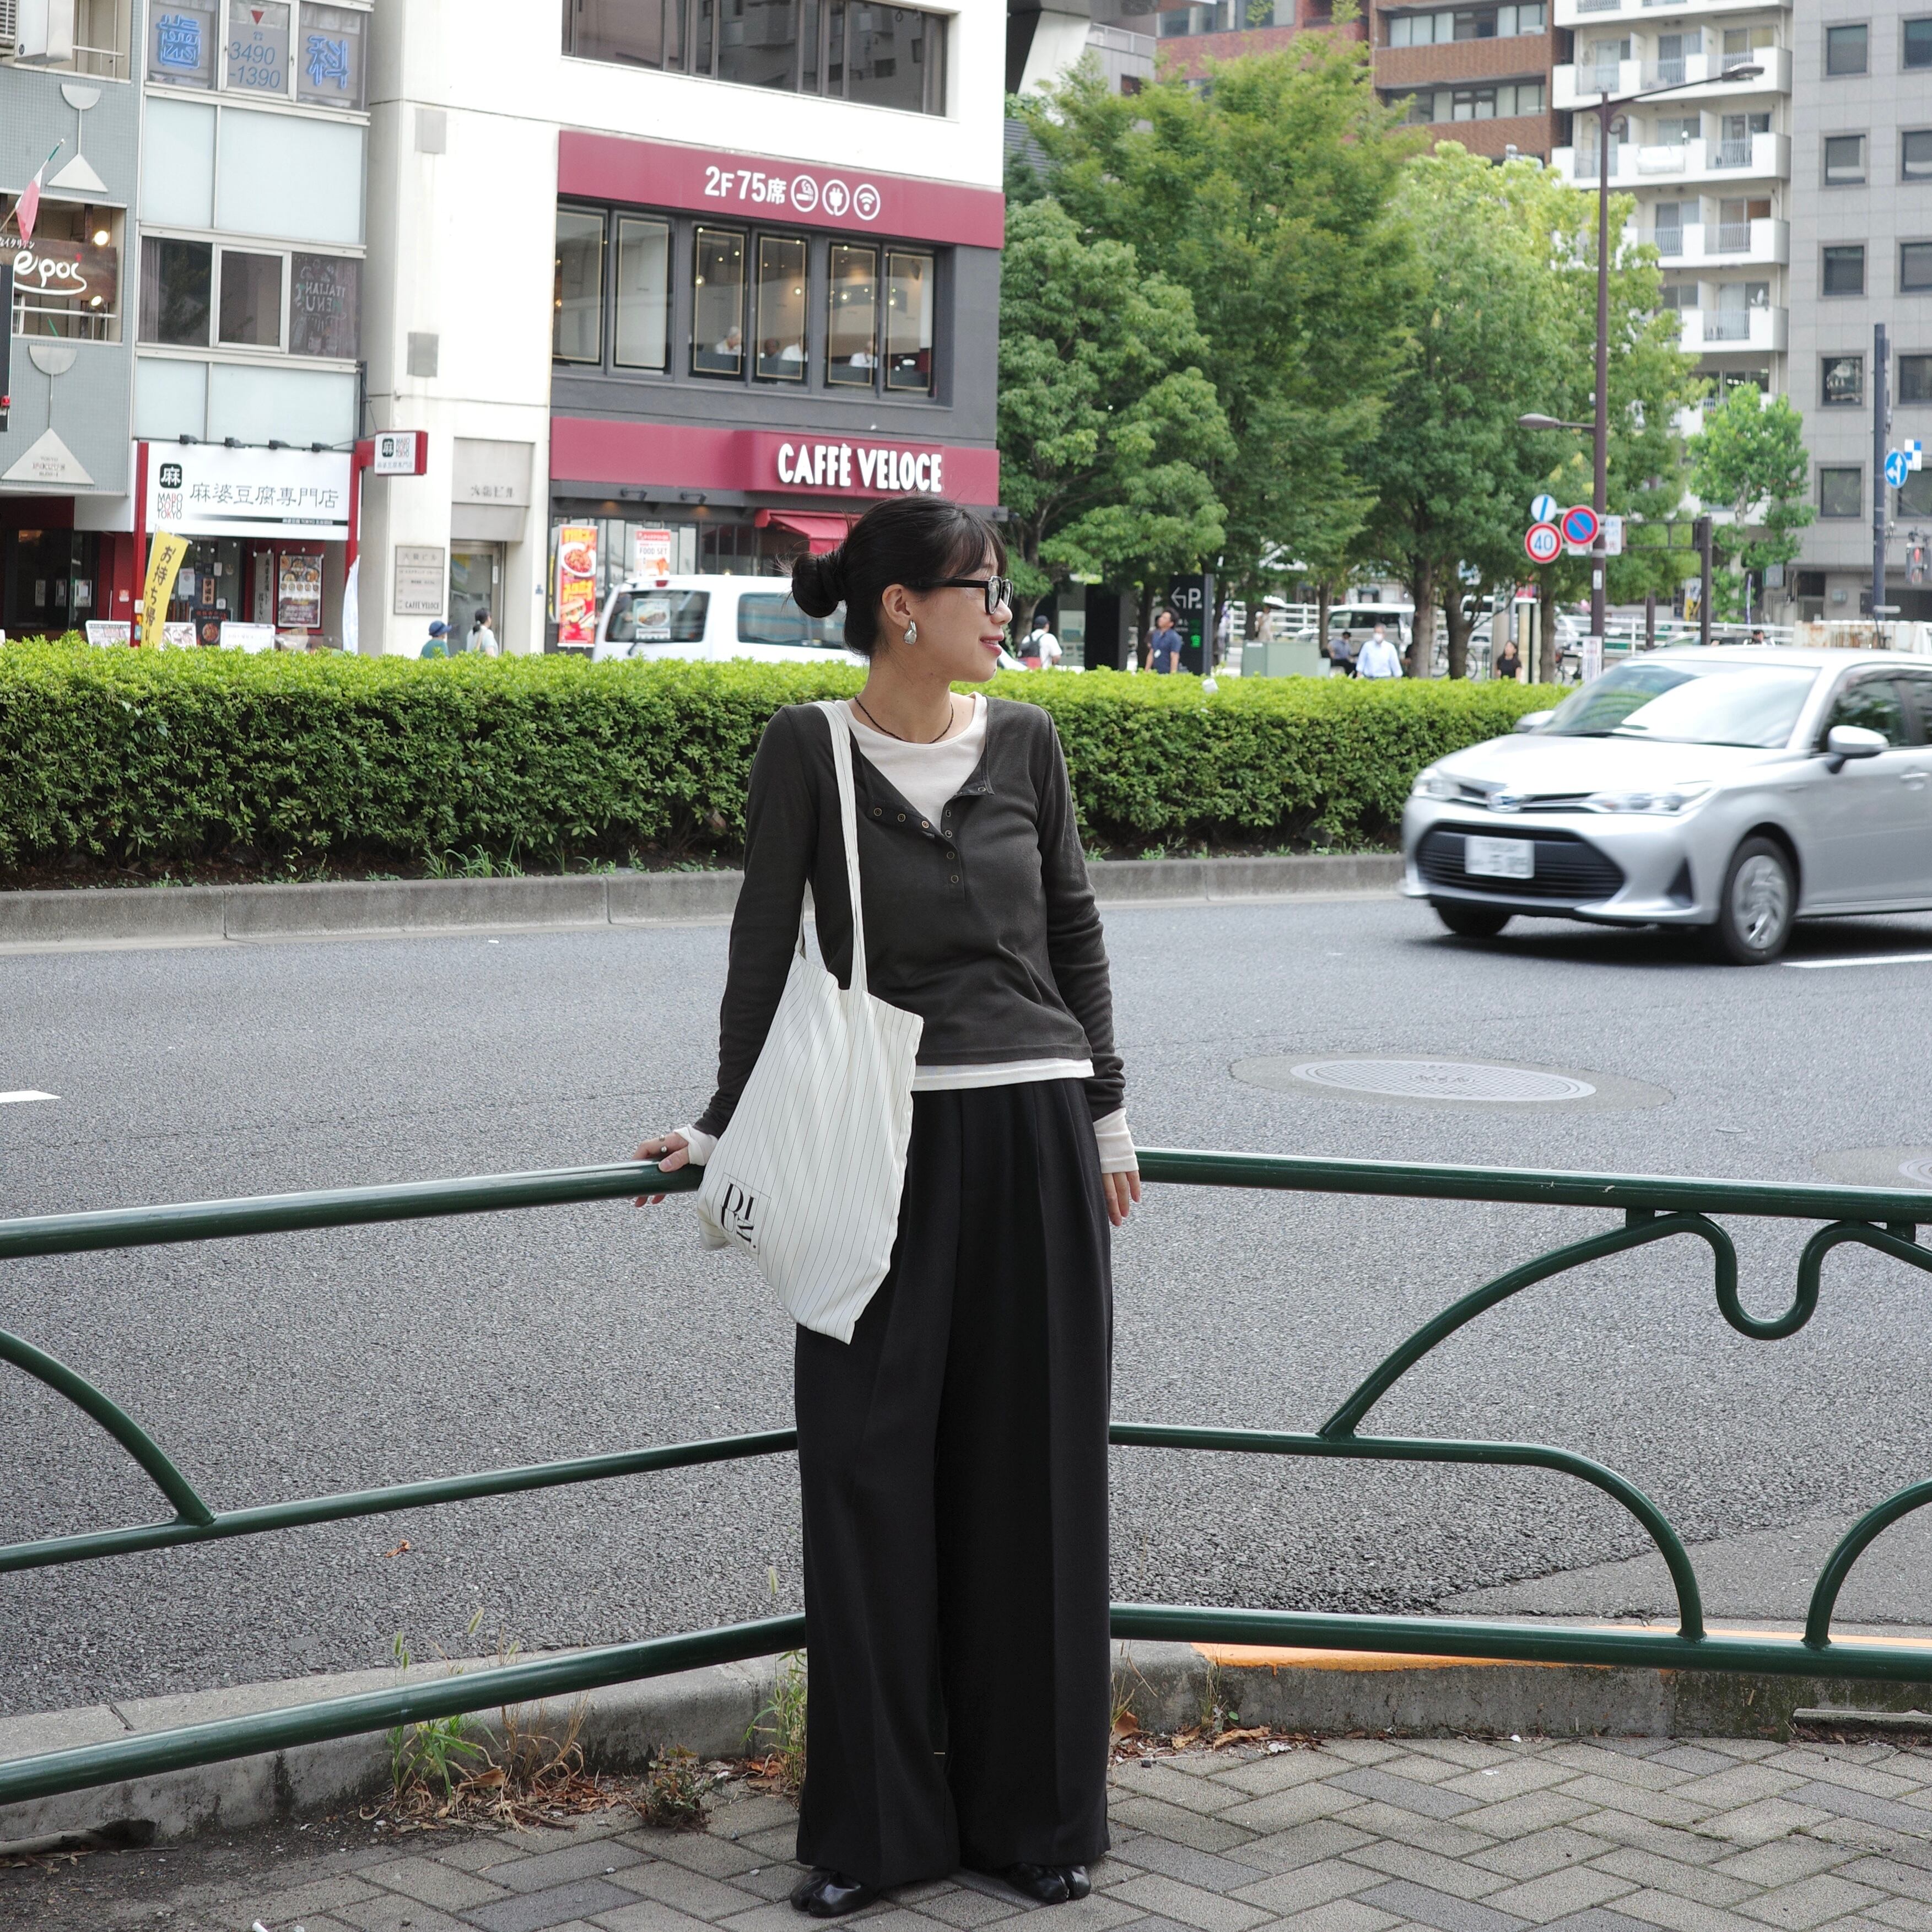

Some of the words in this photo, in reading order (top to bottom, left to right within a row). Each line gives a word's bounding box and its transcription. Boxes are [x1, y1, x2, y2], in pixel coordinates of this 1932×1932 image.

[156, 14, 201, 69] 歯
[307, 35, 348, 89] 科
[229, 42, 275, 65] 3490
[229, 66, 280, 89] -1390
[160, 466, 181, 487] 麻
[778, 443, 851, 487] CAFFÈ
[857, 449, 942, 493] VELOCE
[158, 493, 183, 502] MABO
[190, 482, 339, 509] 麻婆豆腐専門店
[157, 510, 182, 520] TOKYO
[1534, 534, 1553, 551] 40
[422, 602, 439, 610] VELOCE
[1188, 587, 1201, 609] P
